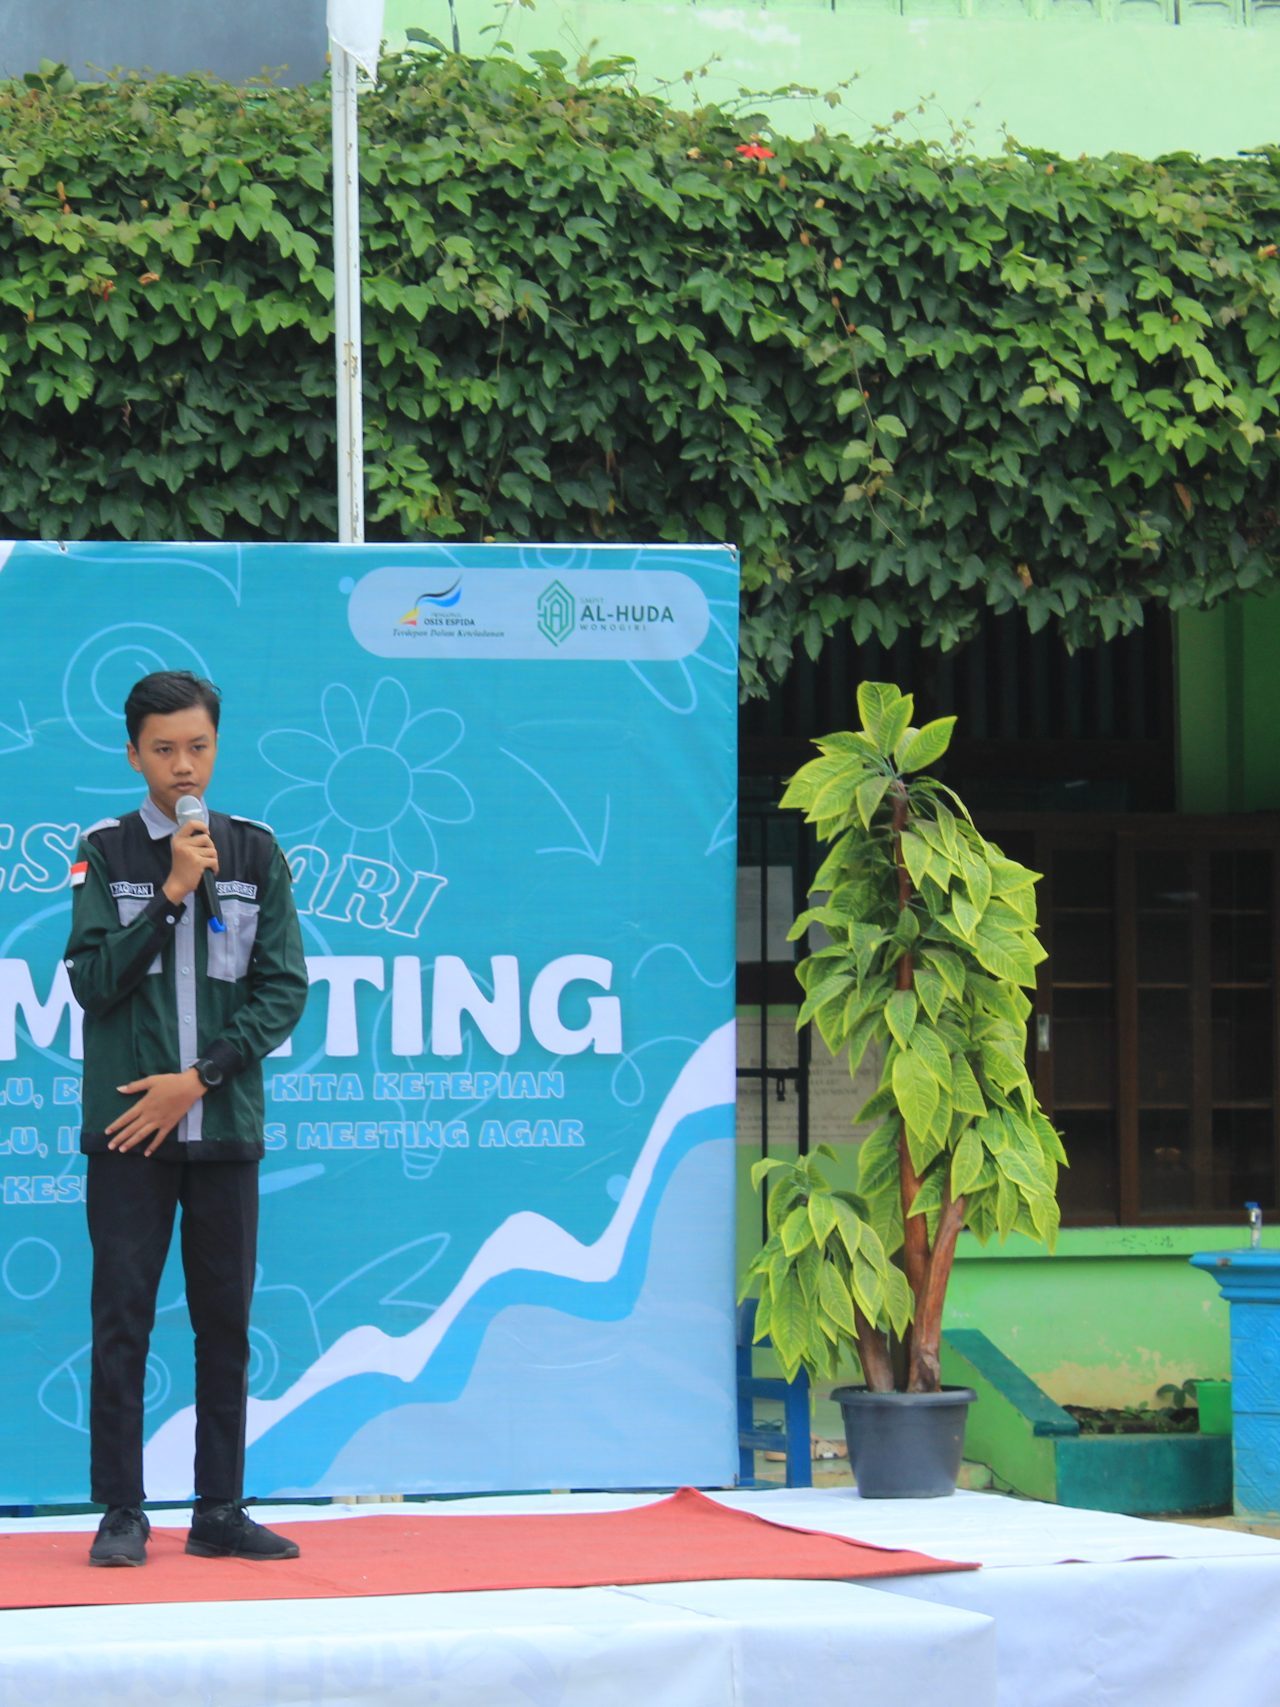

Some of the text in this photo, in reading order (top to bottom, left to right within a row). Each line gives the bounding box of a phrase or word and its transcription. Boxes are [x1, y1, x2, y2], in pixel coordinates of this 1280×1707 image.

[580, 605, 674, 622] AL-HUDA
[271, 1073, 364, 1101] KITA
[373, 1071, 564, 1100] KETEPIAN
[296, 1120, 470, 1149] MEETING
[478, 1119, 585, 1147] AGAR
